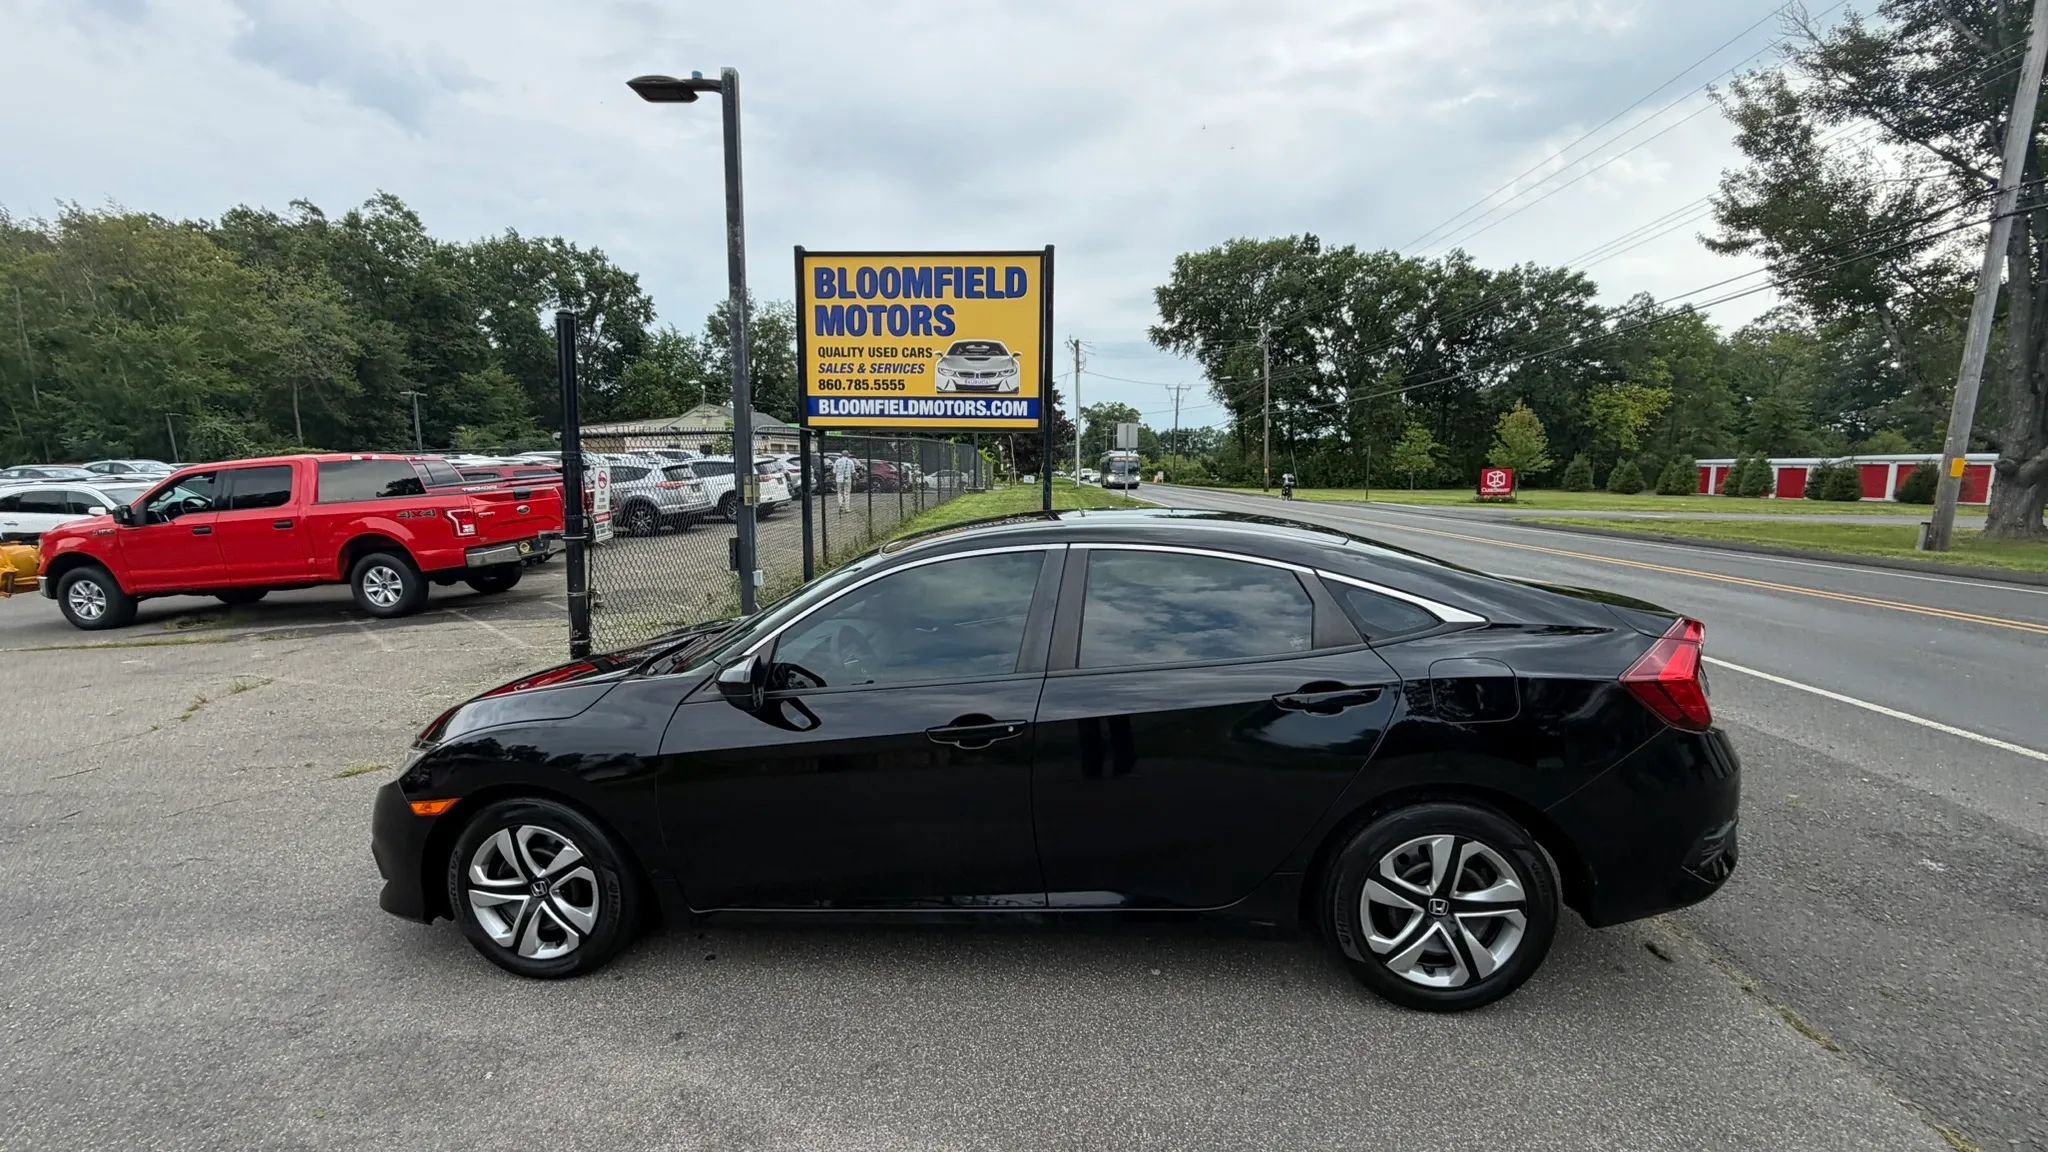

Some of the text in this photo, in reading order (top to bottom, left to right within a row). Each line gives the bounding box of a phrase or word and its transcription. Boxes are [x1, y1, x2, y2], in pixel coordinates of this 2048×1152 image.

[814, 266, 1028, 299] BLOOMFIELD
[814, 304, 956, 337] MOTORS
[818, 346, 933, 359] QUALITY USED CARS
[818, 363, 925, 374] SALES & SERVICES
[818, 379, 906, 391] 860.785.5555
[818, 399, 1028, 416] BLOOMFIELDMOTORS.COM
